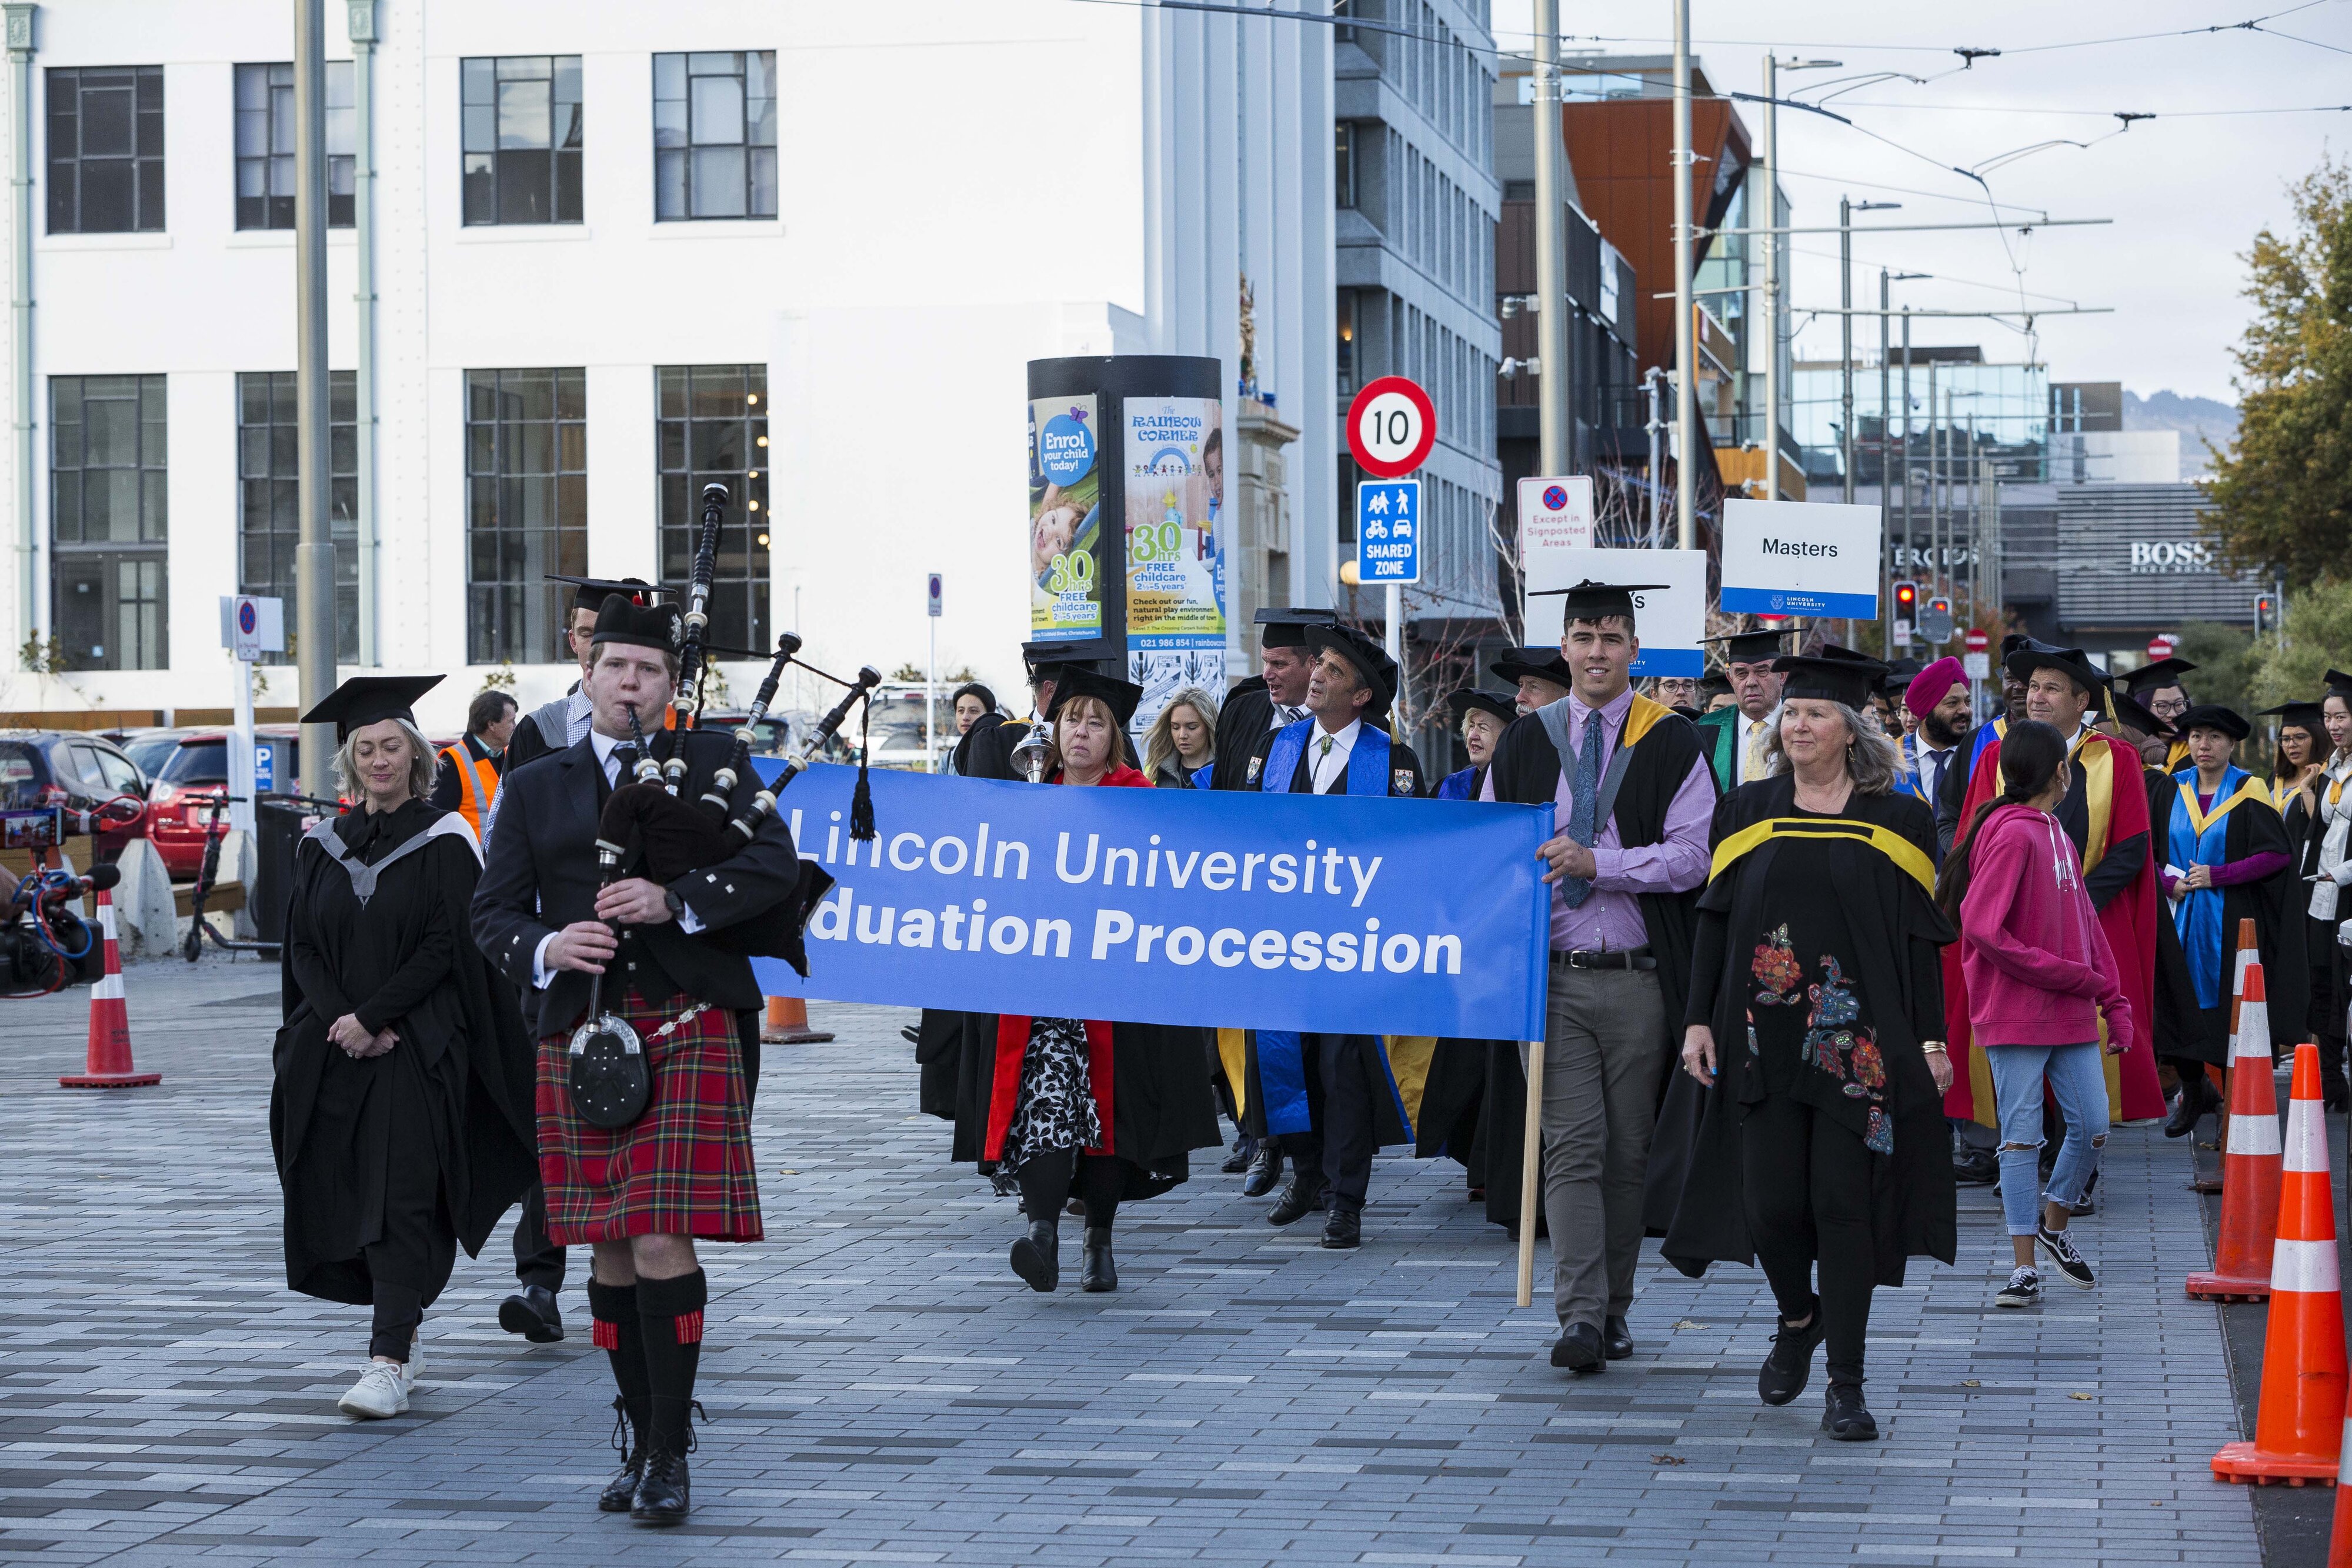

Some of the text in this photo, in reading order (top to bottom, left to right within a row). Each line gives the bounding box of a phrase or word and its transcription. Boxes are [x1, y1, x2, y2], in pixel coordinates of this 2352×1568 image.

[1132, 415, 1202, 428] RAINBOW
[1374, 411, 1409, 445] 10
[1045, 431, 1085, 449] Enrol
[1138, 429, 1198, 442] CORNER
[1043, 448, 1089, 463] your child
[1050, 459, 1079, 472] today!
[1533, 514, 1580, 524] Except in
[1527, 526, 1586, 537] Signposted
[1133, 522, 1182, 561] 30
[1763, 538, 1838, 557] Masters
[1157, 548, 1181, 561] hrs
[1366, 543, 1412, 559] SHARED
[2131, 541, 2213, 565] BOSS
[1051, 550, 1094, 592] 30
[1147, 563, 1175, 572] FREE
[1375, 561, 1404, 575] ZONE
[1069, 578, 1093, 591] hrs
[1135, 573, 1186, 582] childcare
[1060, 592, 1085, 601] FREE
[1052, 602, 1097, 612] childcare
[256, 748, 271, 767] P
[790, 809, 1383, 909] Lincoln University
[809, 887, 1462, 975] duation Procession
